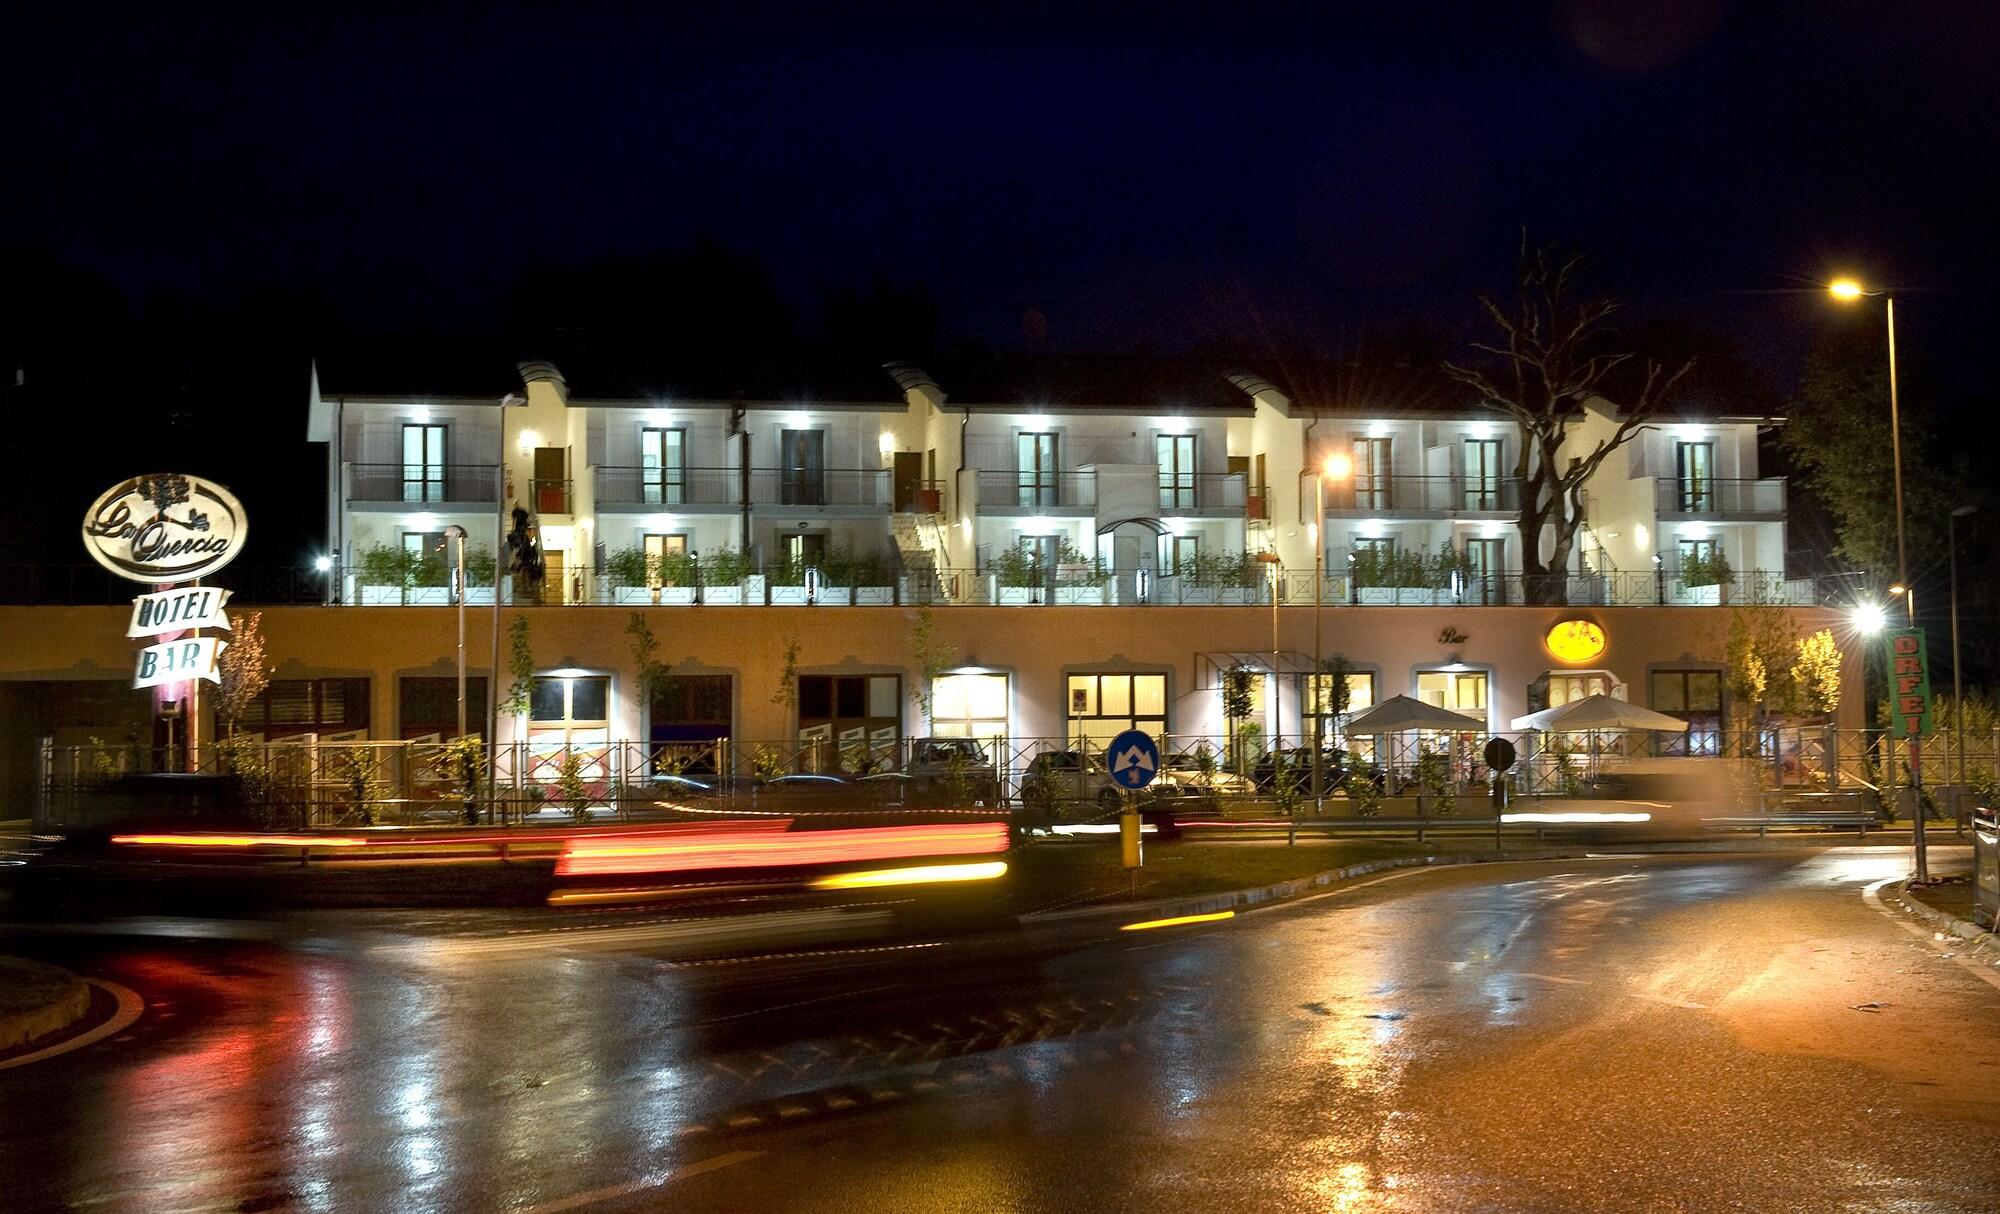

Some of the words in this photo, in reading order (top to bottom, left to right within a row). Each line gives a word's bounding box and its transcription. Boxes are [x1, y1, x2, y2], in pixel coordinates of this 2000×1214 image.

[85, 501, 136, 538] La
[131, 521, 227, 561] Quercia
[138, 592, 210, 627] HOTEL
[139, 643, 201, 679] BAR
